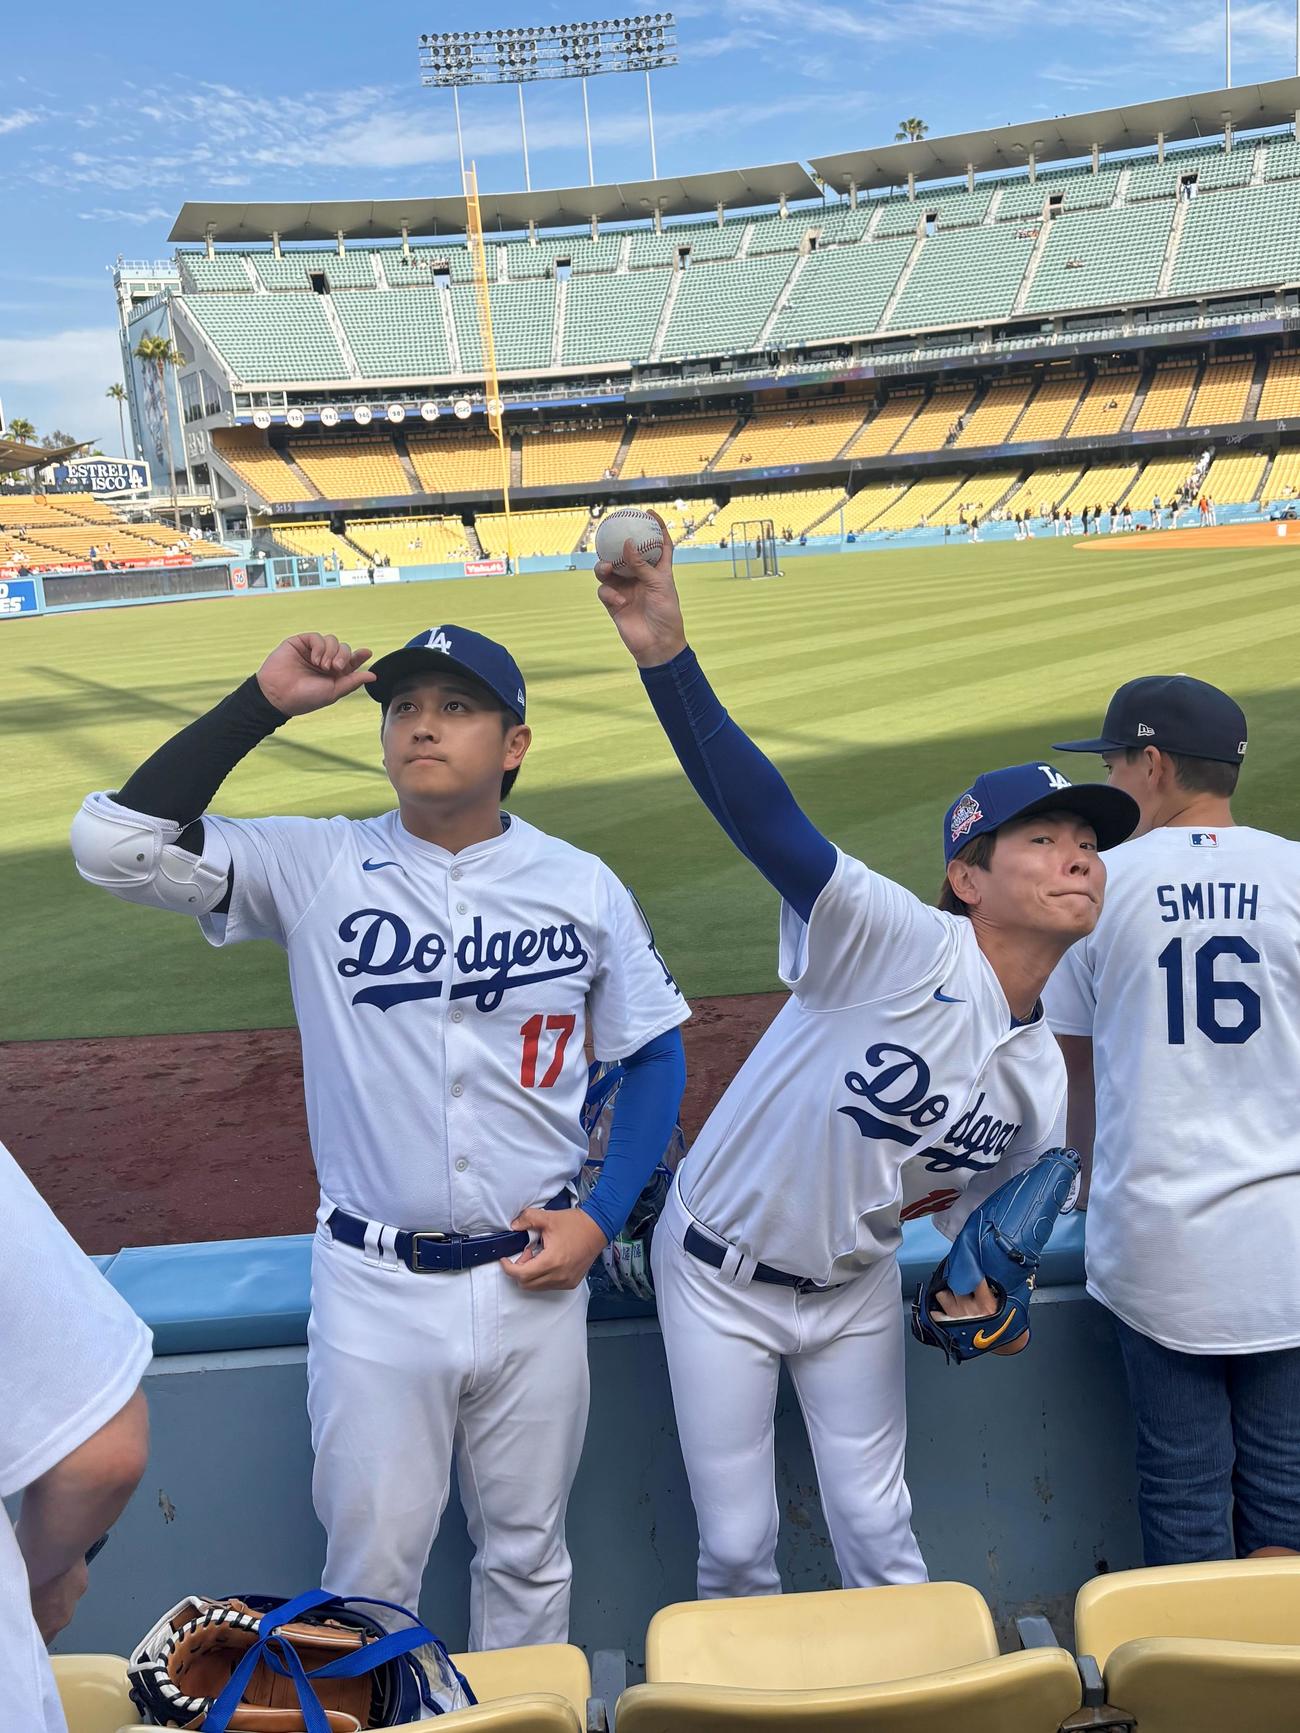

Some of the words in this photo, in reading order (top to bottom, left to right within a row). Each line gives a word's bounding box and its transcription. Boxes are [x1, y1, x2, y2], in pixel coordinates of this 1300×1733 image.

[235, 572, 245, 582] 76
[424, 627, 452, 655] LA
[1038, 766, 1073, 790] LA
[1157, 882, 1259, 923] SMITH
[338, 908, 588, 1013] Dodgers
[1158, 935, 1262, 1045] 16
[519, 1014, 576, 1089] 17
